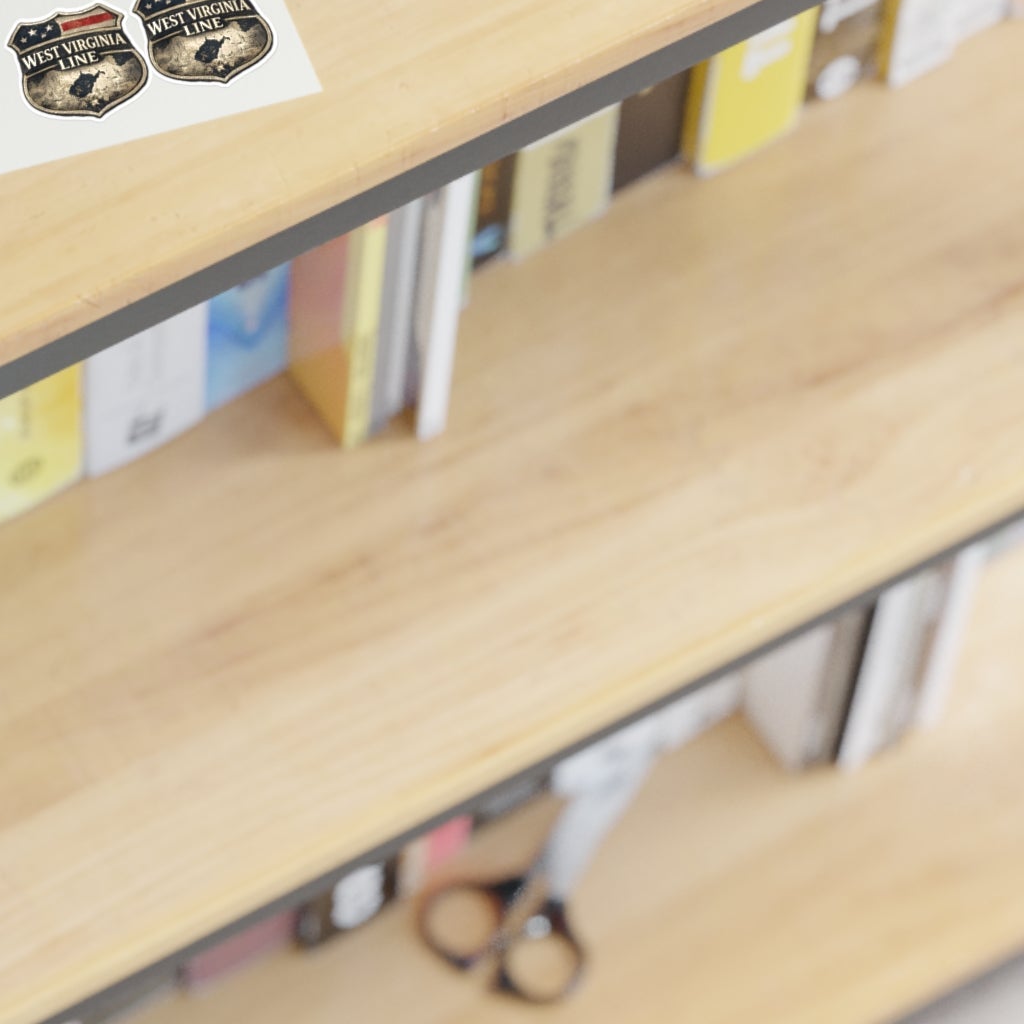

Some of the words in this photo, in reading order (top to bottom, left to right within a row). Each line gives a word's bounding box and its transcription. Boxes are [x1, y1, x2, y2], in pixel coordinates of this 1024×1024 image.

[145, 11, 186, 37] WEST
[187, 0, 251, 23] VIRGINIA
[182, 17, 225, 37] LINE
[22, 46, 62, 71] WEST
[63, 32, 128, 58] VIRGINIA
[57, 50, 100, 71] LINE
